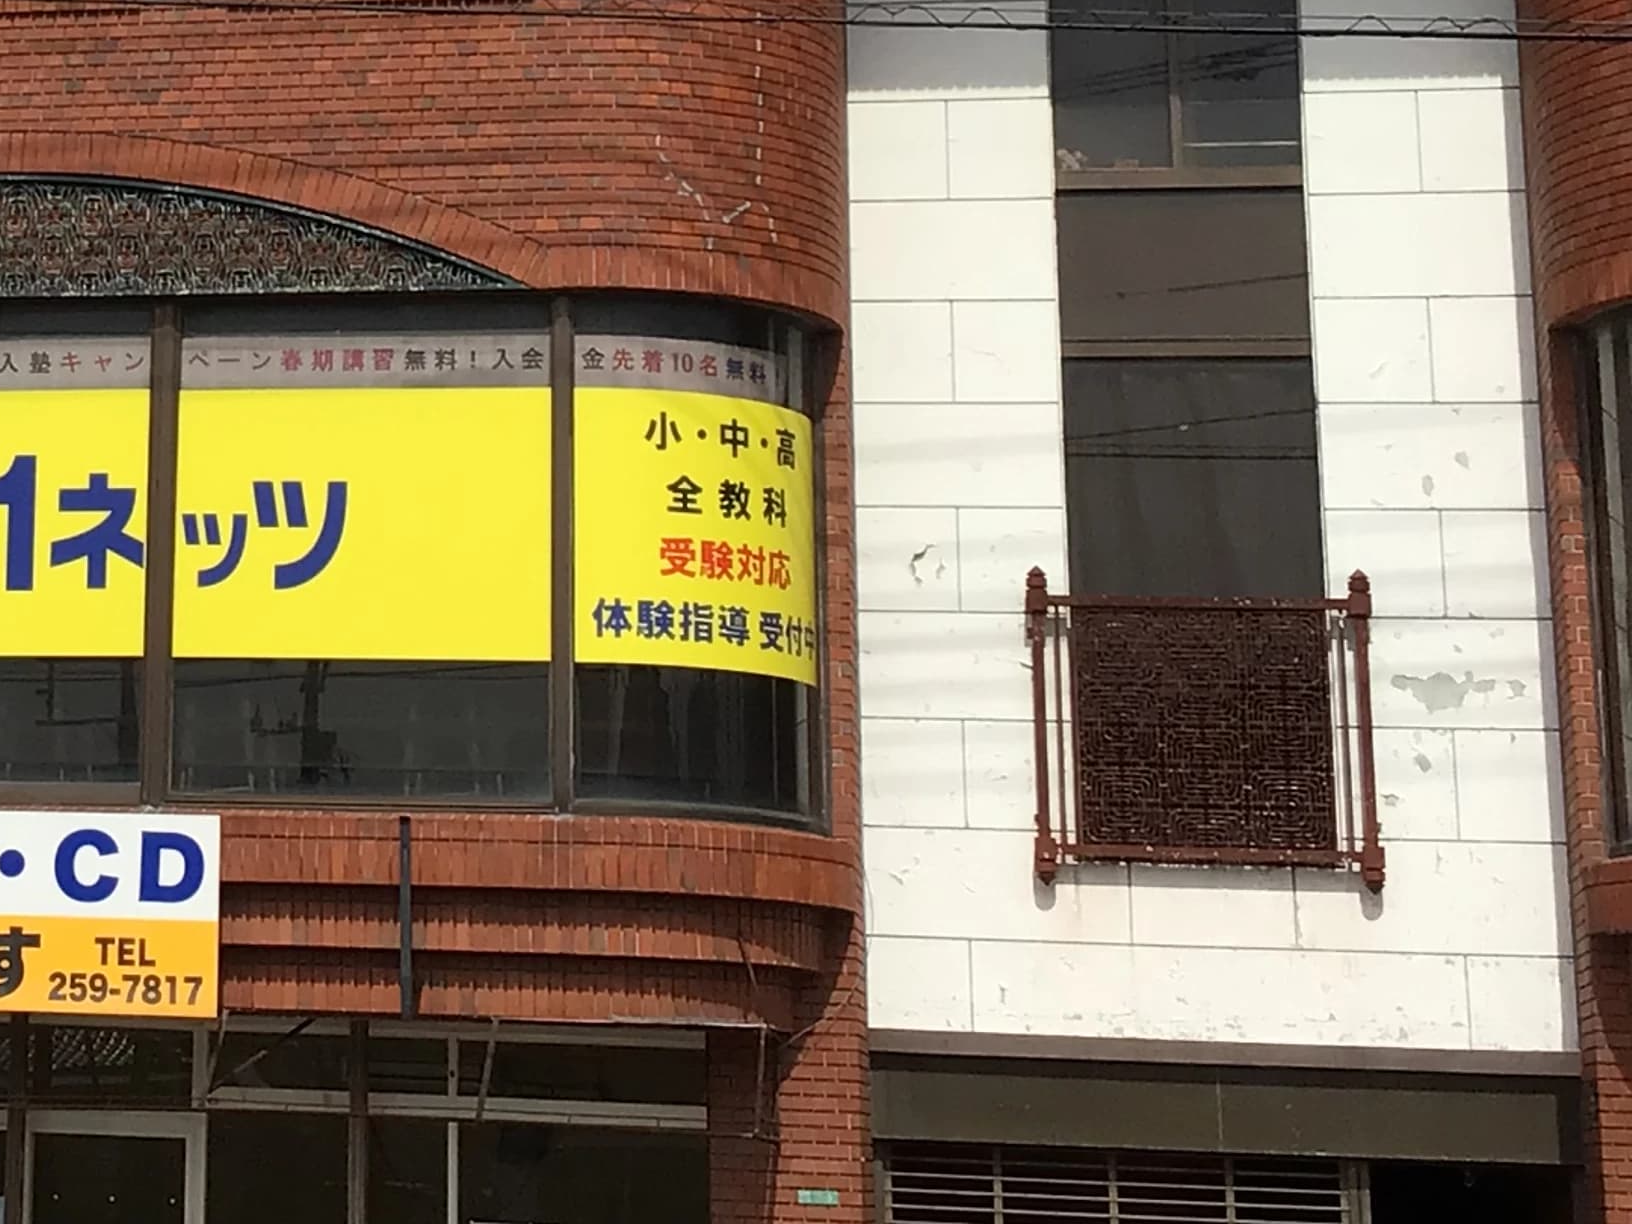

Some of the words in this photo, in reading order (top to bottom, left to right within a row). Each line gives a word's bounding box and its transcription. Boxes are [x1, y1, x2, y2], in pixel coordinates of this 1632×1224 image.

[645, 411, 797, 471] 小・中・高
[666, 475, 788, 528] 全教科
[659, 536, 792, 591] 受験対応
[94, 936, 157, 967] TEL
[47, 971, 204, 1006] 259-7817
